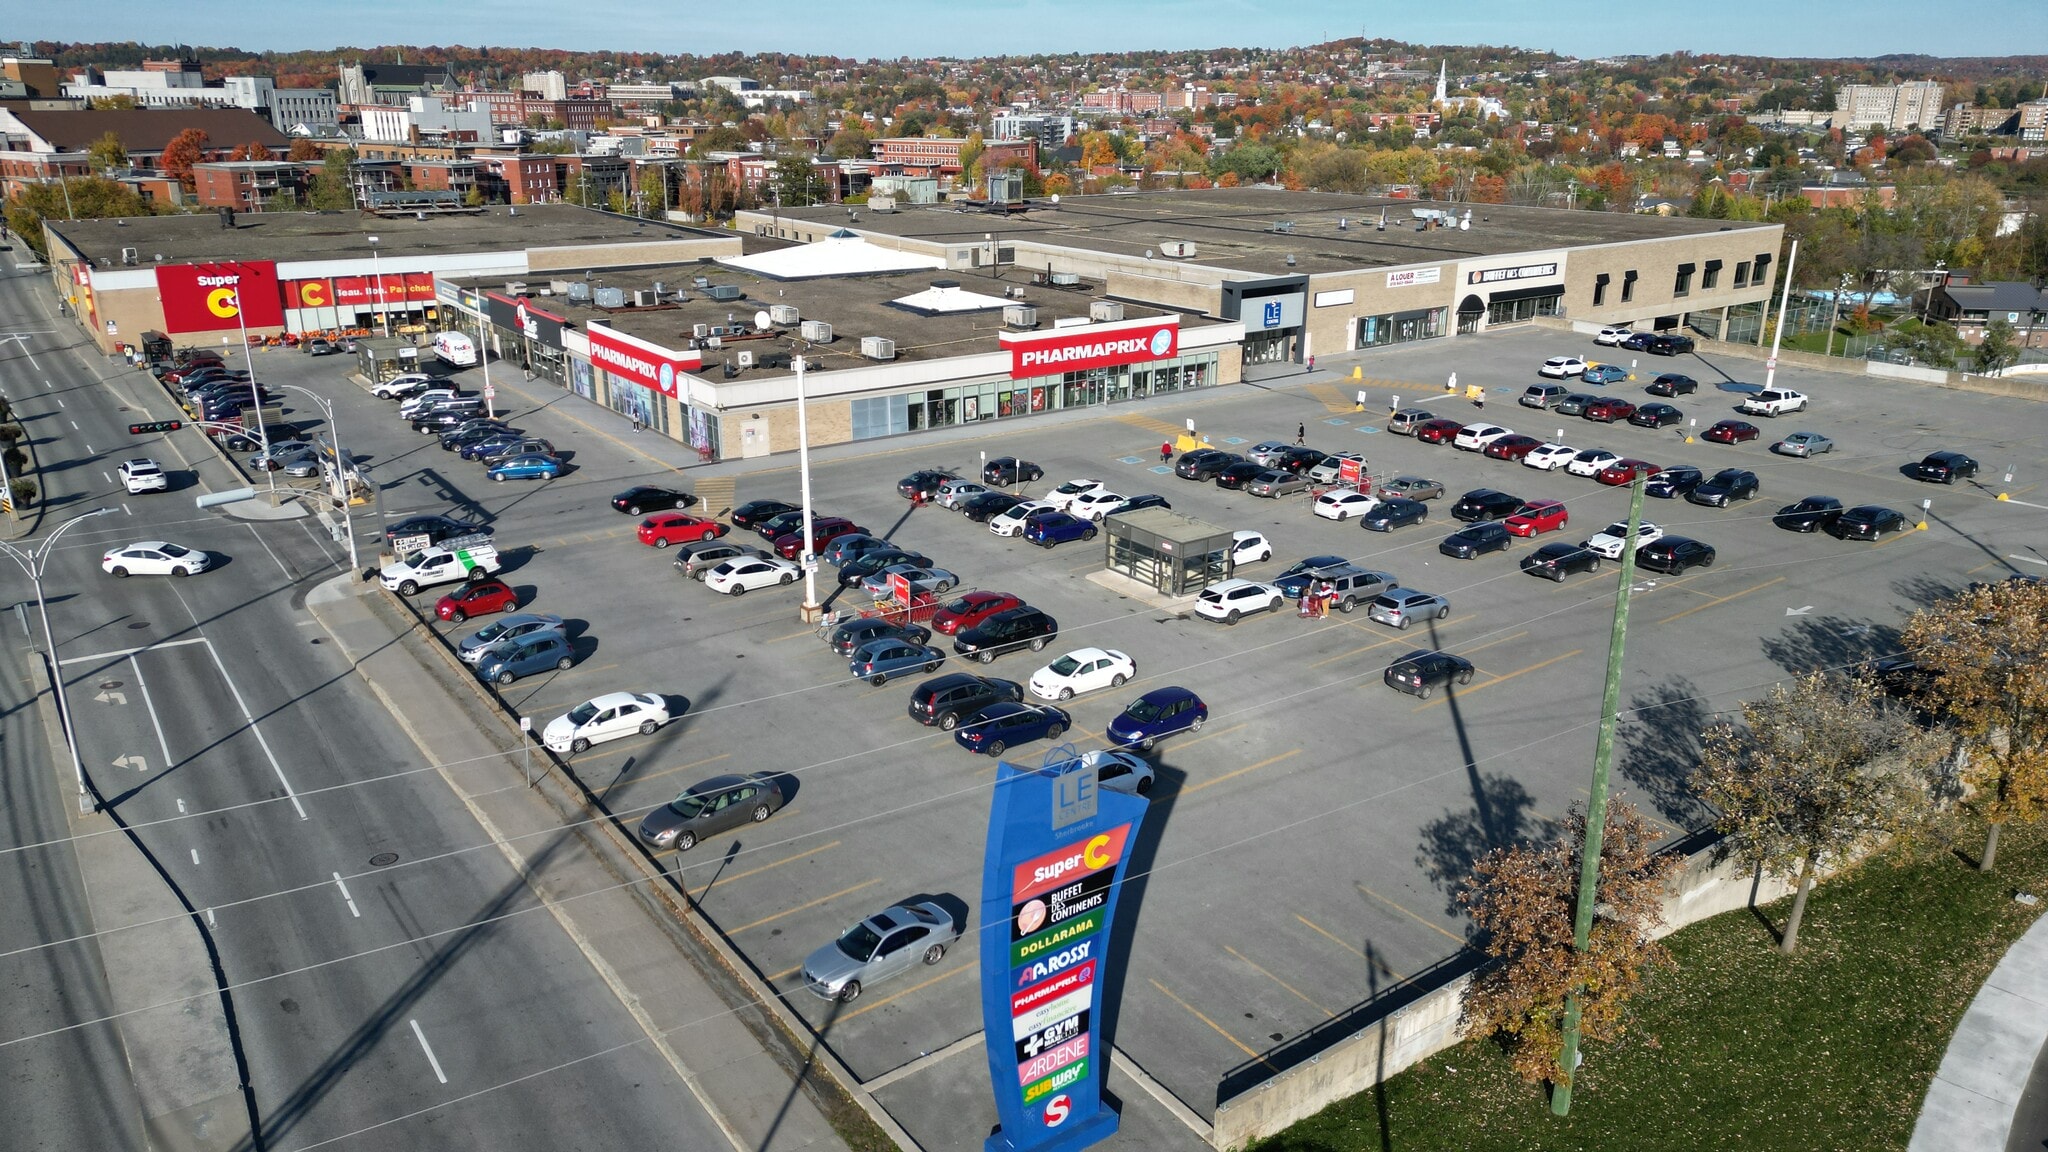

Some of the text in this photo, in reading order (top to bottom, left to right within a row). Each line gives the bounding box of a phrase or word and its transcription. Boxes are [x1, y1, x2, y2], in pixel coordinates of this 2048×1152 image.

[197, 275, 240, 287] Super
[409, 284, 432, 293] cher.
[1396, 272, 1414, 281] LOUER
[207, 288, 239, 318] C
[301, 283, 325, 306] C
[1267, 306, 1280, 319] LE
[591, 342, 658, 380] PHARMAPRIX
[1022, 337, 1147, 366] PHARMAPRIX
[1061, 773, 1092, 808] LE
[1059, 800, 1093, 820] CENTRE
[1055, 821, 1094, 839] Sherbrooke
[1034, 834, 1111, 882] Super C
[1051, 883, 1082, 904] BUFFET
[1051, 901, 1065, 914] DES
[1051, 894, 1103, 922] CONTINENTS
[1021, 919, 1094, 957] DOLLARAMA
[1048, 940, 1091, 973] ROSSY
[1014, 975, 1078, 1008] PHARMAPRIX
[1044, 1015, 1079, 1039] GYM
[1021, 1038, 1085, 1083] ARDENE
[1024, 1062, 1084, 1102] SUBWAY
[1046, 1094, 1069, 1127] S
